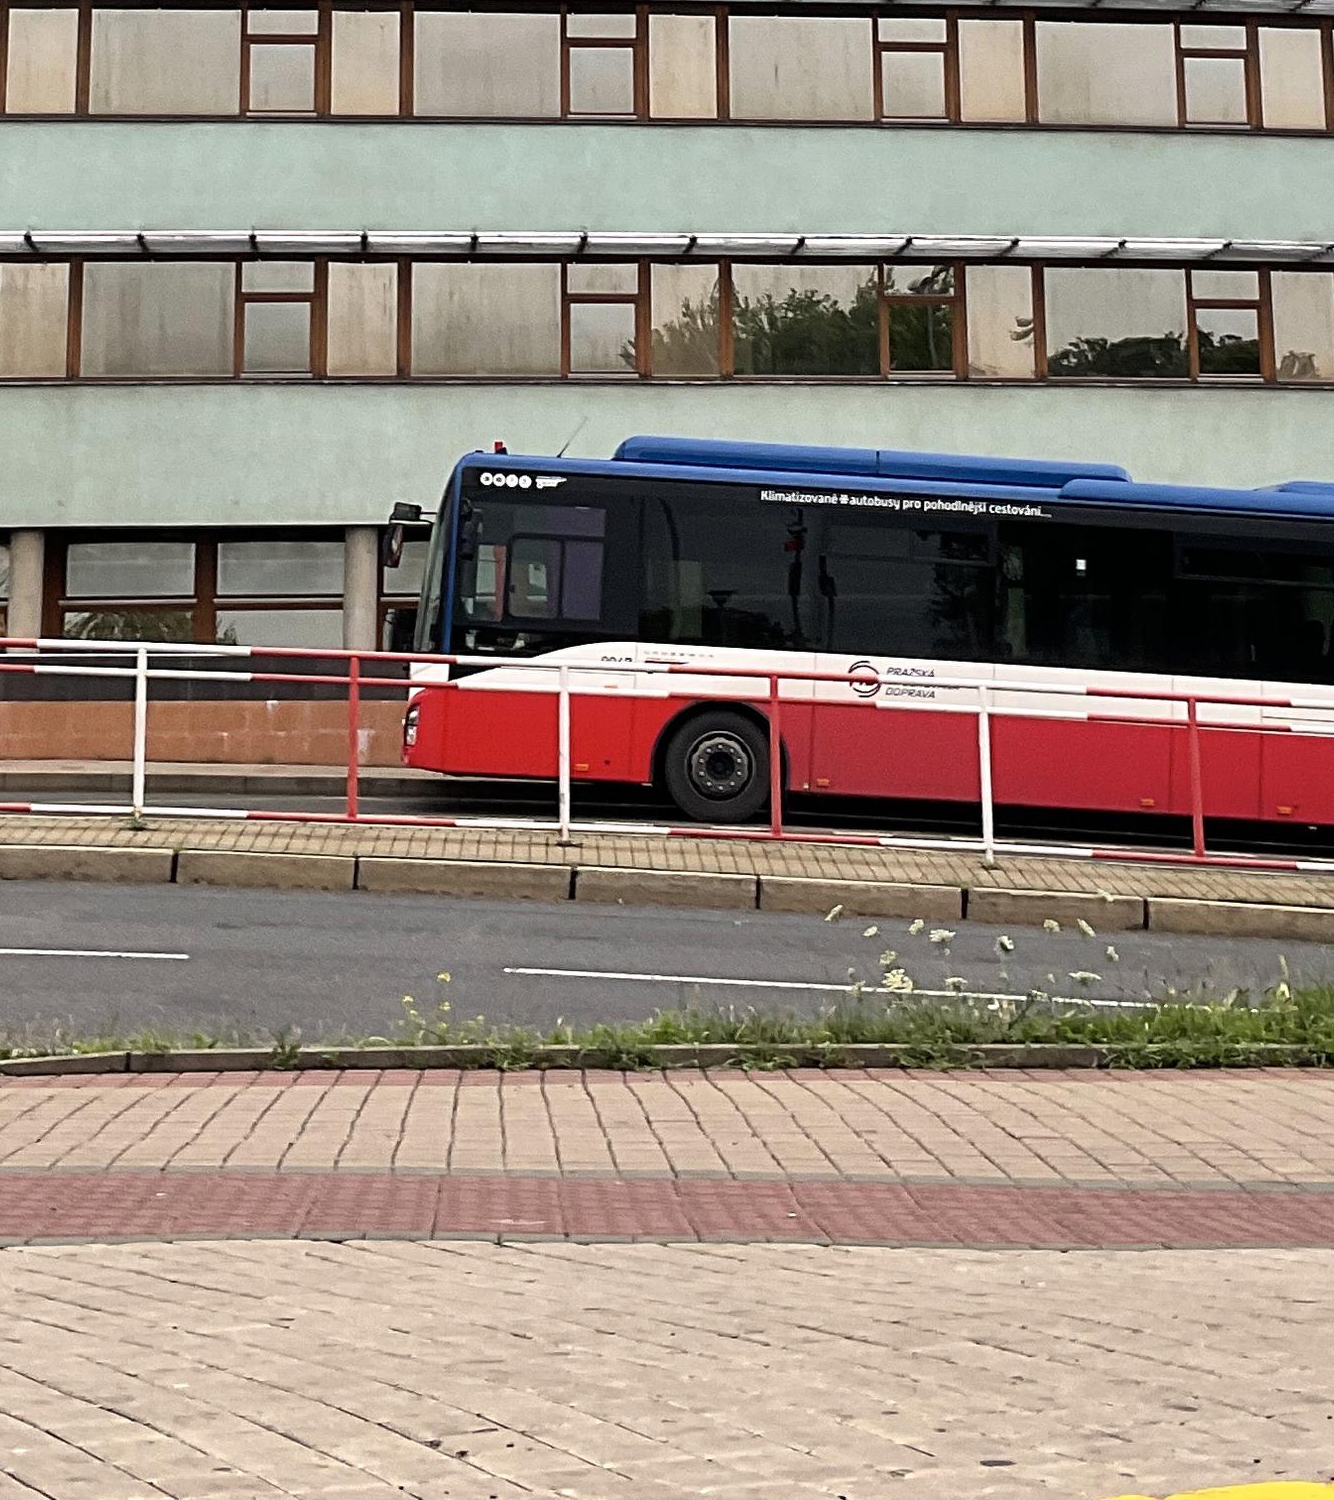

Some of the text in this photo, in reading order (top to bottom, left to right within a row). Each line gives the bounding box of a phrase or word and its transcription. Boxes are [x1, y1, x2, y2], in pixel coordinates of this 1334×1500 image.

[760, 490, 838, 504] Klimatizované
[849, 496, 900, 510] autobusy
[903, 499, 921, 510] pro
[886, 687, 935, 698] DOPRAVA
